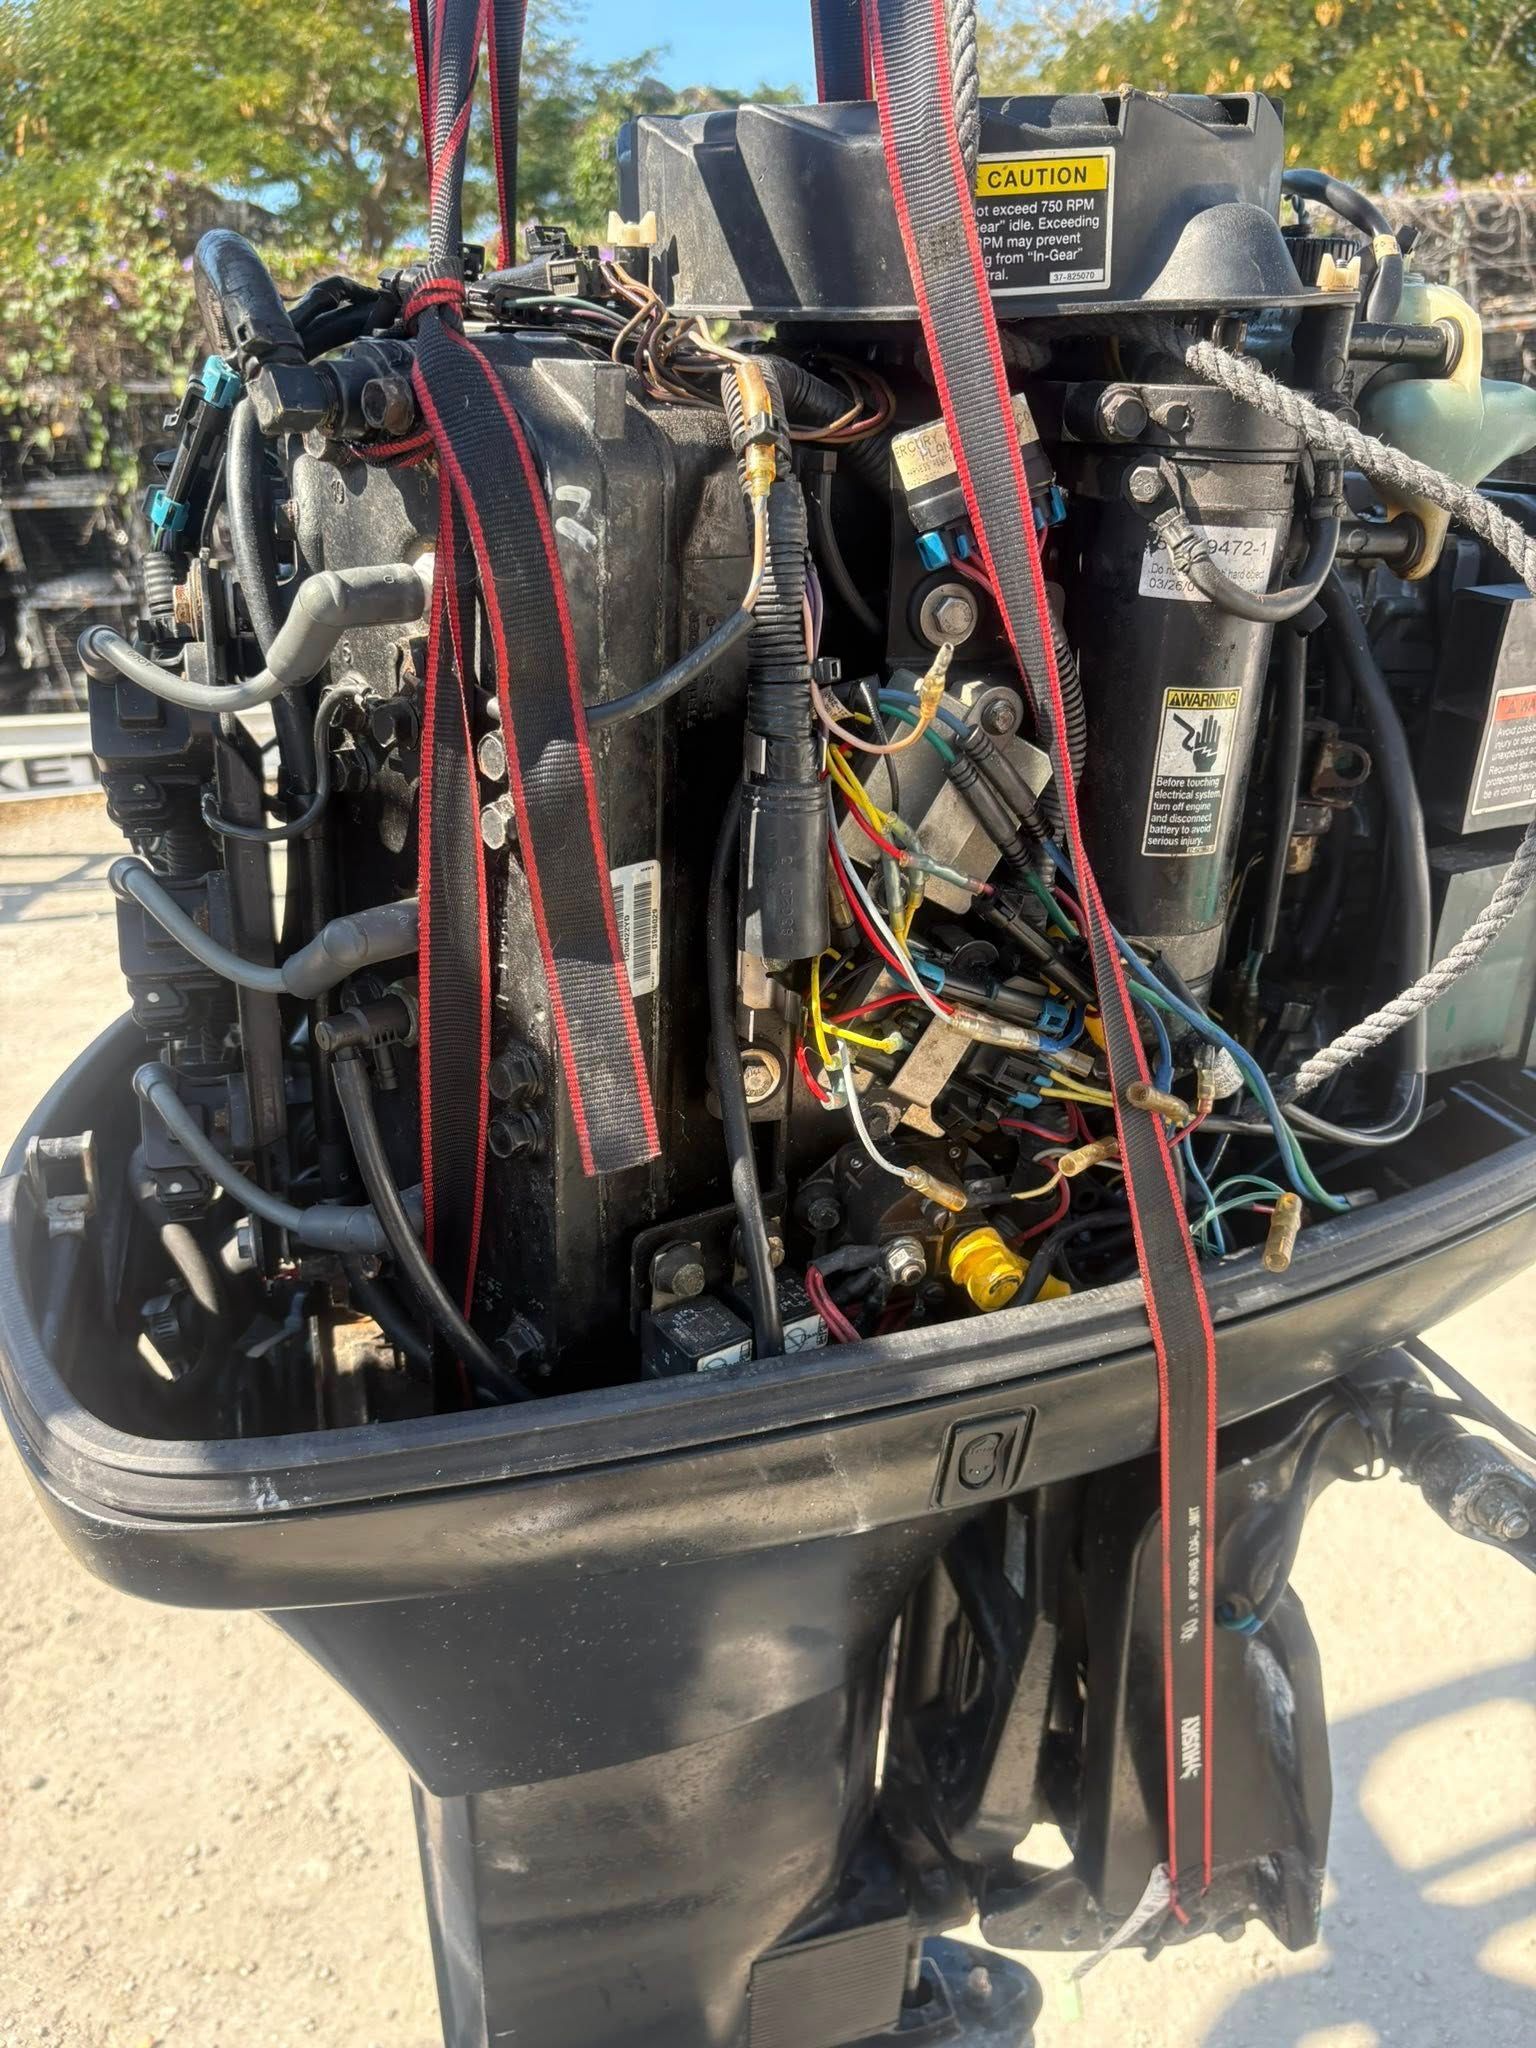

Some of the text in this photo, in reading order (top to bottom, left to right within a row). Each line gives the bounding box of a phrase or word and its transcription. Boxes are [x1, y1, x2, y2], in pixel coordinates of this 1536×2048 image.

[987, 166, 1087, 189] CAUTION
[992, 201, 1037, 216] exceed
[1041, 200, 1063, 213] 750
[1066, 198, 1094, 212] RPM
[1009, 218, 1034, 231] idle.
[1039, 216, 1099, 230] Exceeding
[1007, 237, 1032, 250] may
[1036, 232, 1081, 248] prevent
[996, 252, 1024, 265] from
[1053, 271, 1095, 281] 37-825070
[894, 431, 938, 459] ERCURY
[1149, 577, 1195, 592] 03/26/0
[1181, 692, 1236, 707] WARNING
[1156, 777, 1220, 788] Before touching
[1154, 789, 1194, 800] electrical
[1153, 802, 1211, 813] turn off engine
[1151, 813, 1212, 823] and disconnect
[1149, 823, 1211, 836] battery to avoid
[1147, 836, 1203, 847] serious injury.
